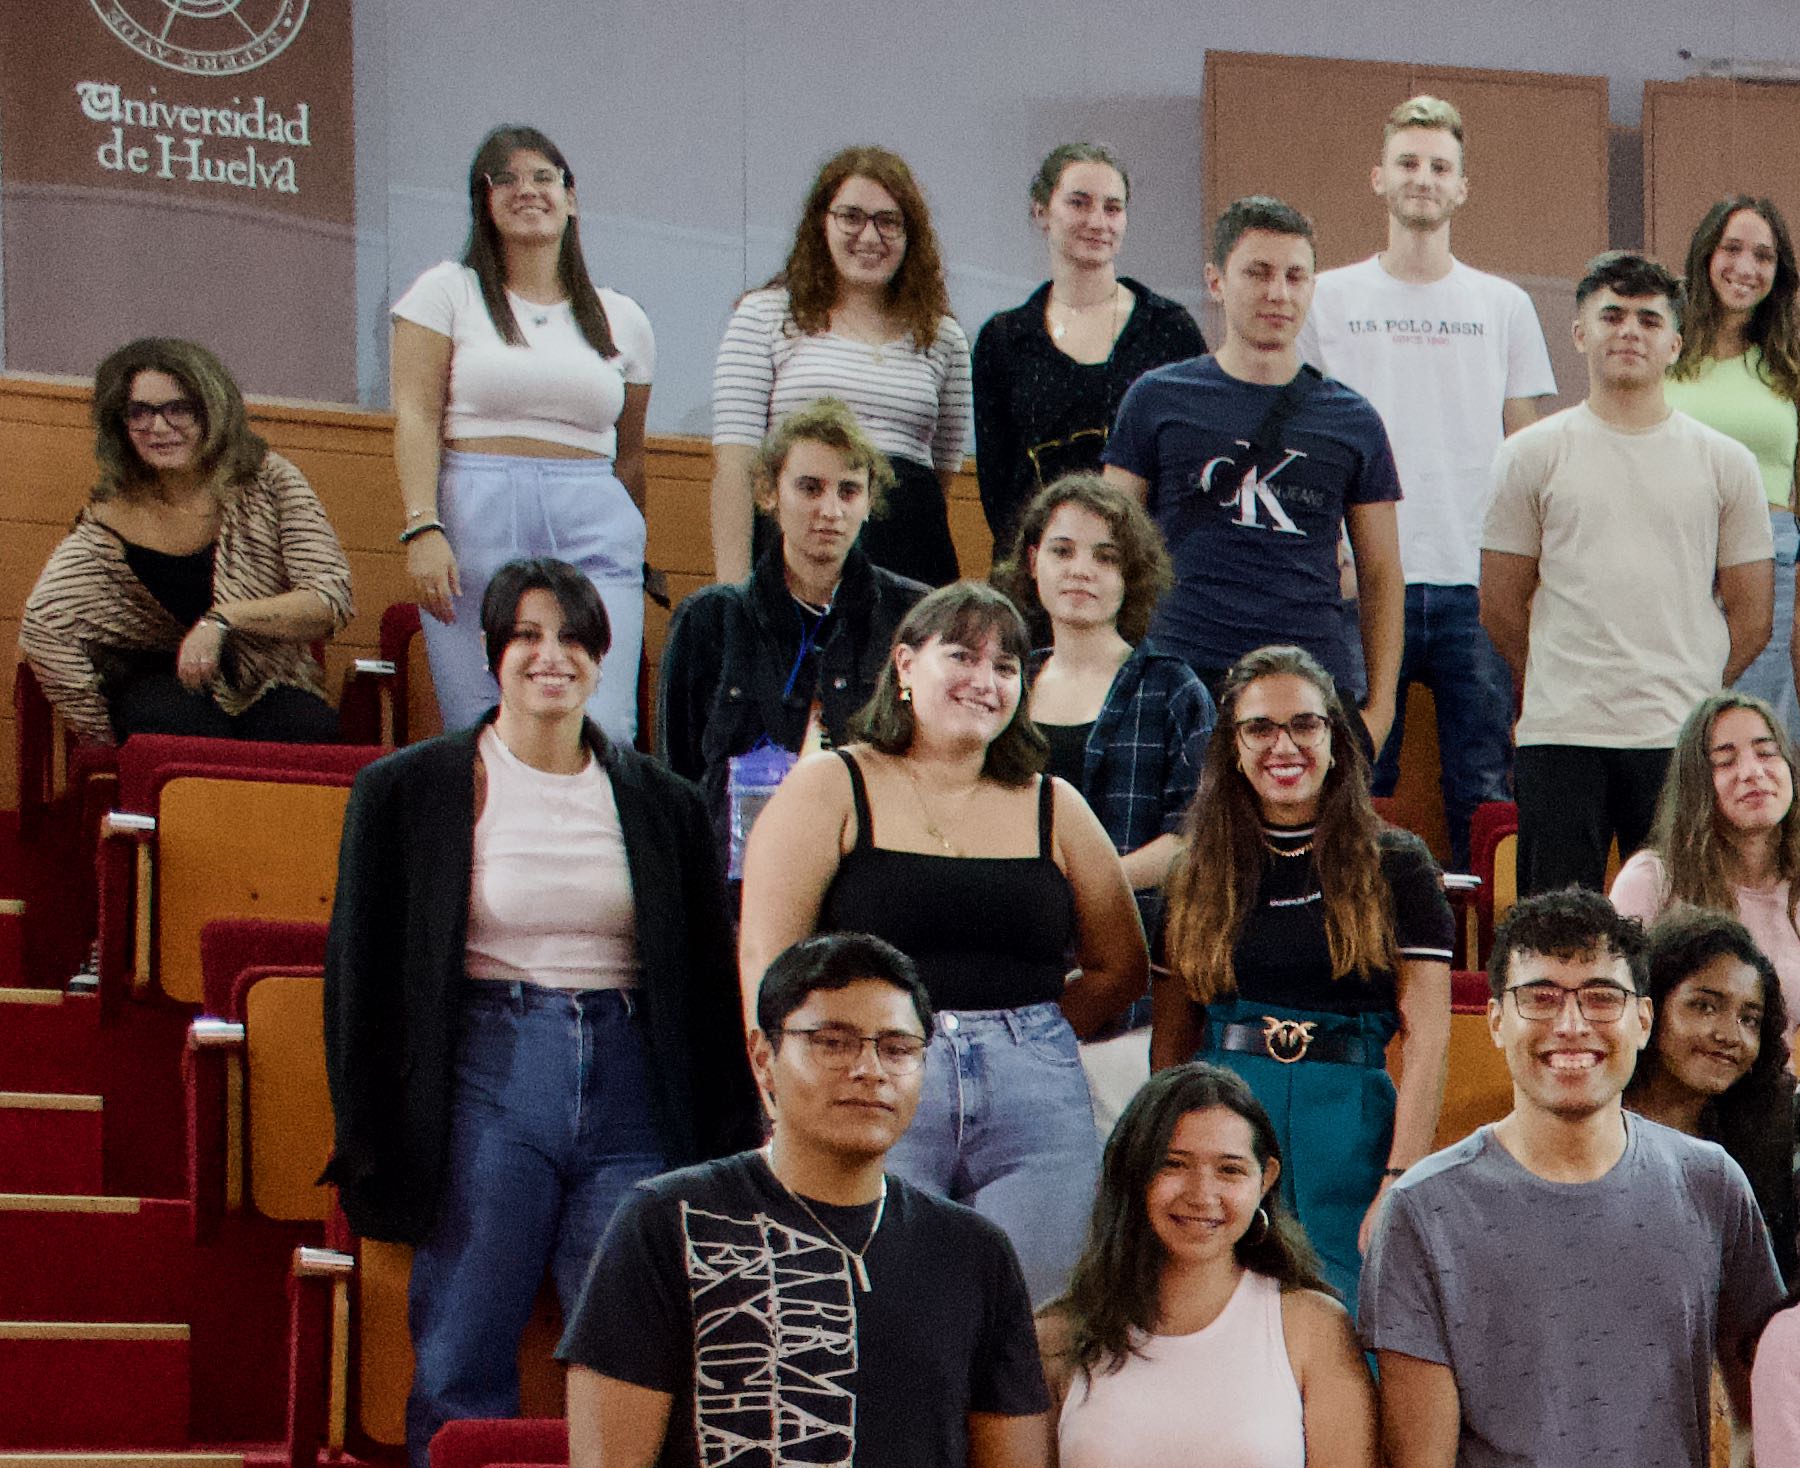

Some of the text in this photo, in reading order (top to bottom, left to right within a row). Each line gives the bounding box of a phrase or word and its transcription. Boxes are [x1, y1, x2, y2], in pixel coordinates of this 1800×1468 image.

[75, 80, 312, 147] Universidad
[97, 127, 299, 194] de Huelva
[1385, 319, 1433, 335] POLO
